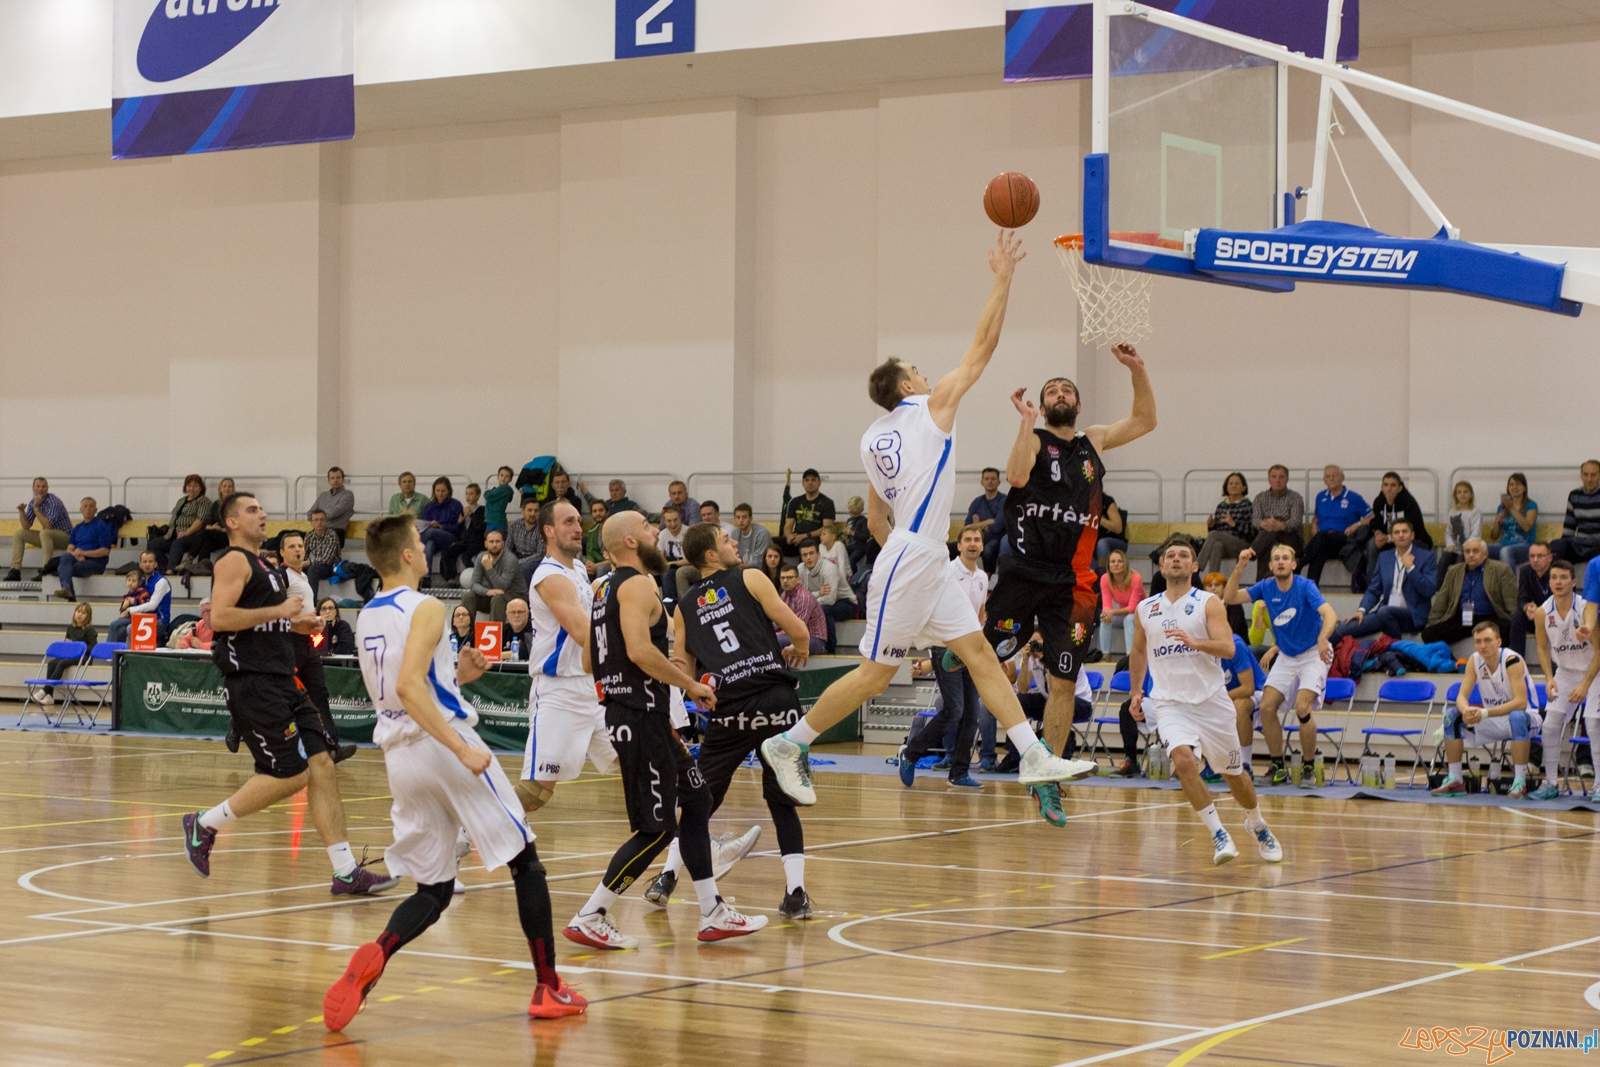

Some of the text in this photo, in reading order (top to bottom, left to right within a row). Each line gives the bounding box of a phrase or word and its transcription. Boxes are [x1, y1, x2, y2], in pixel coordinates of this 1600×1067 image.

[869, 430, 902, 480] 8
[1050, 460, 1061, 482] 9
[700, 602, 735, 626] ASTORIA
[135, 617, 155, 642] 5
[478, 625, 499, 651] 5
[712, 620, 741, 654] 5
[363, 634, 387, 701] 7
[1059, 651, 1073, 674] 9
[545, 763, 561, 773] PBG
